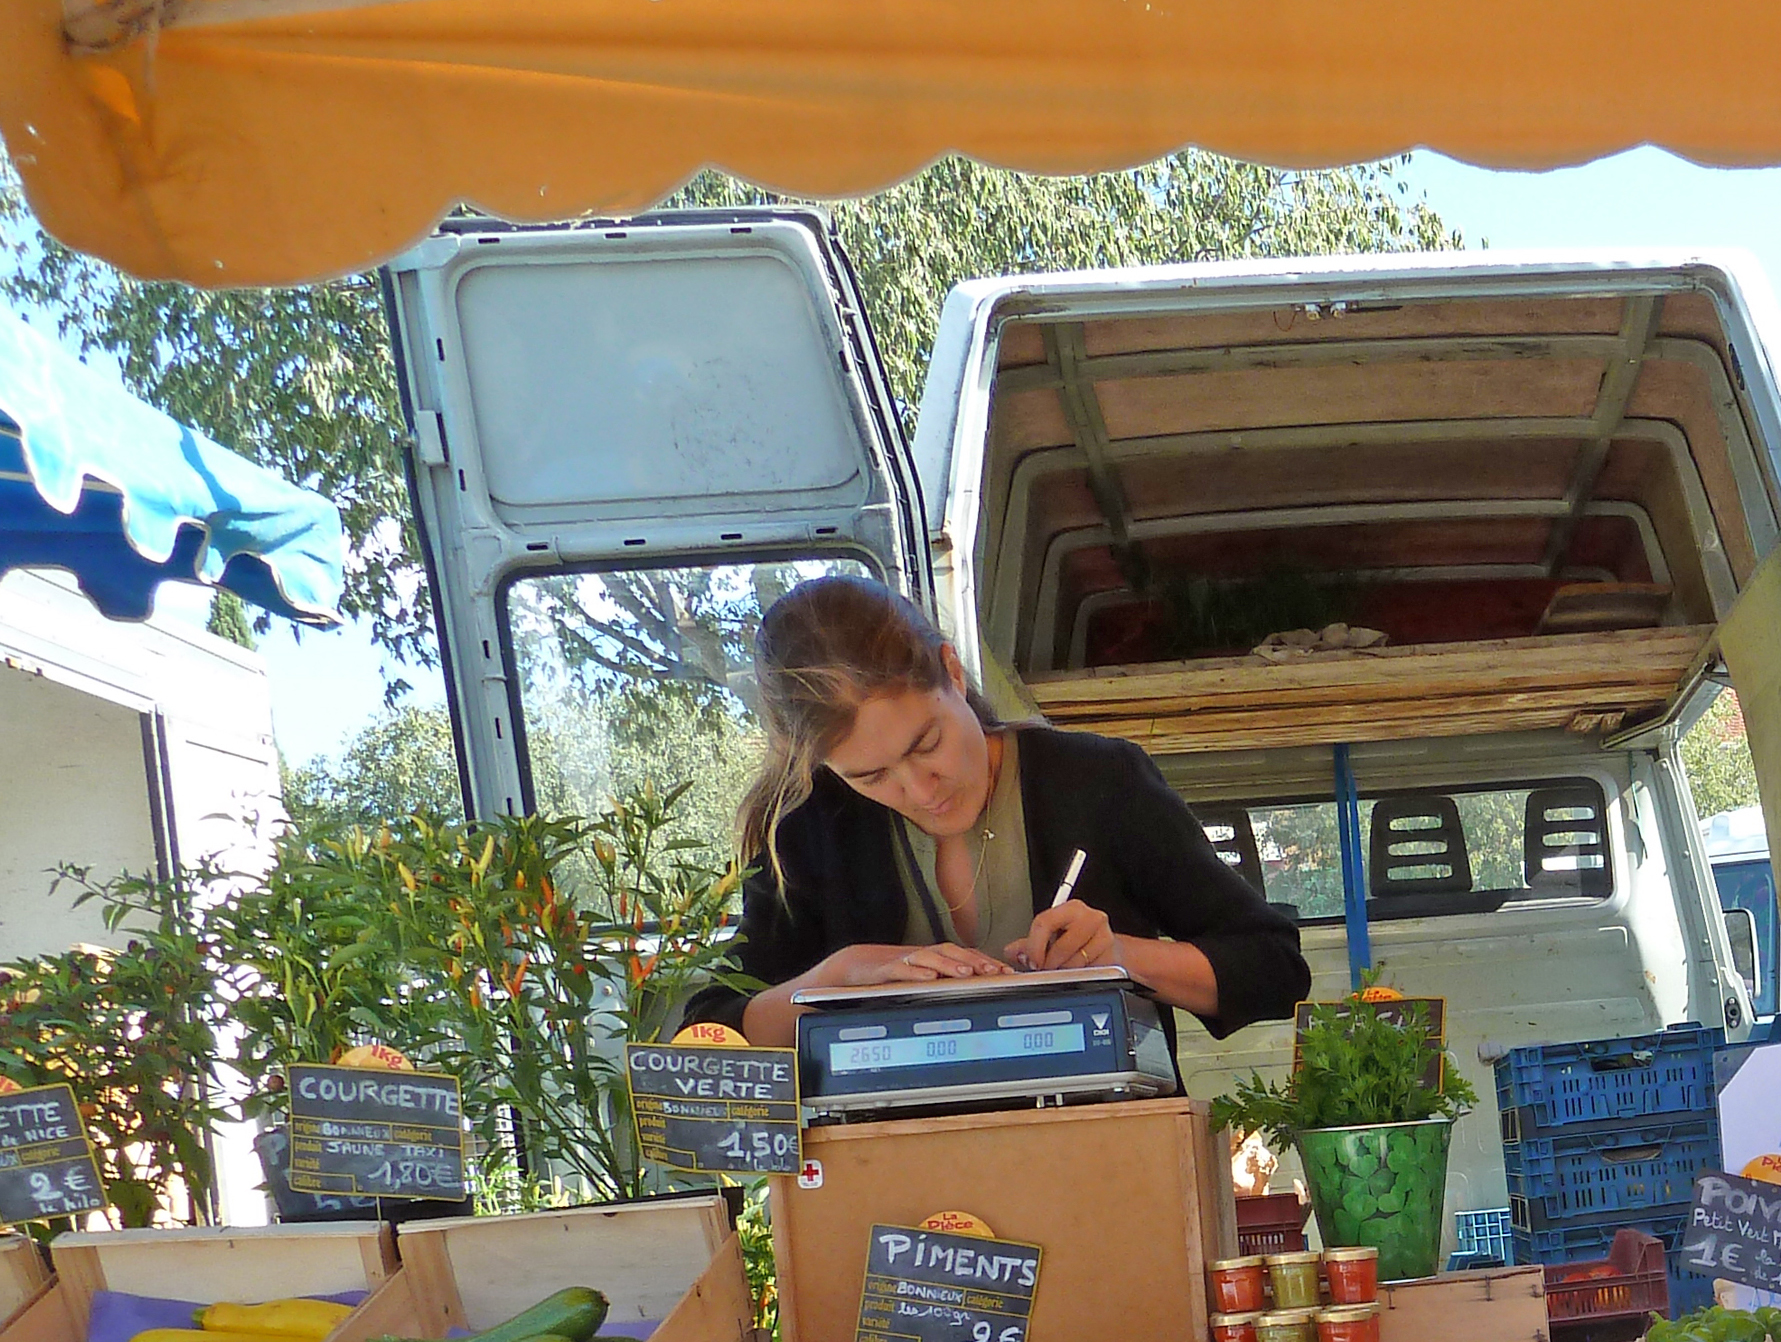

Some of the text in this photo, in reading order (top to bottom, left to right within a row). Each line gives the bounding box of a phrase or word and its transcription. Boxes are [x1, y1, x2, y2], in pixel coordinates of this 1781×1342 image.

[690, 1025, 727, 1043] 1kg
[370, 1045, 403, 1070] 1kg
[629, 1051, 790, 1083] COURGETTE
[299, 1076, 460, 1116] COURGETTE
[675, 1078, 773, 1100] VERTE
[24, 1125, 70, 1142] NICE
[717, 1130, 800, 1163] 1,50€
[63, 1192, 101, 1212] kilo
[943, 1213, 958, 1221] La
[1692, 1207, 1733, 1232] Petit
[1737, 1218, 1770, 1244] Vert
